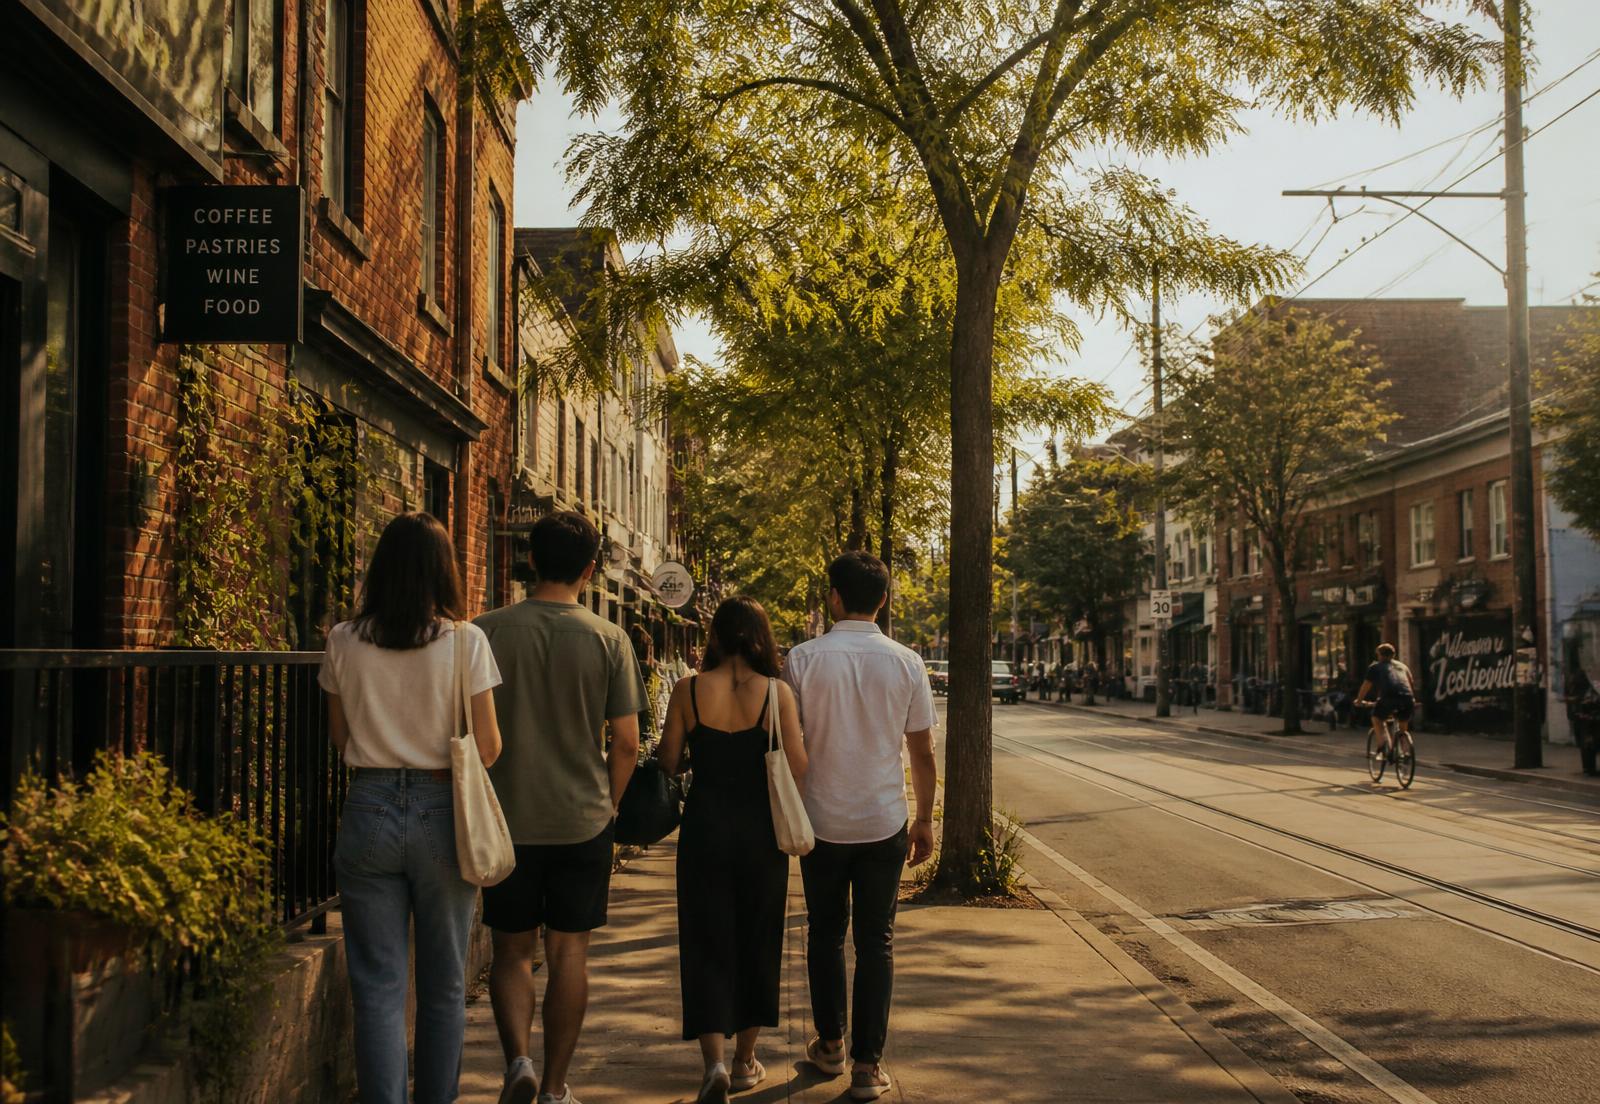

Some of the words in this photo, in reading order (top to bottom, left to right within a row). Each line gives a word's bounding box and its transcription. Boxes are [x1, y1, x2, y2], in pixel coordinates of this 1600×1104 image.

[193, 208, 273, 224] COFFEE
[185, 238, 281, 254] PASTRIES
[206, 268, 260, 284] WINE
[204, 299, 261, 315] FOOD
